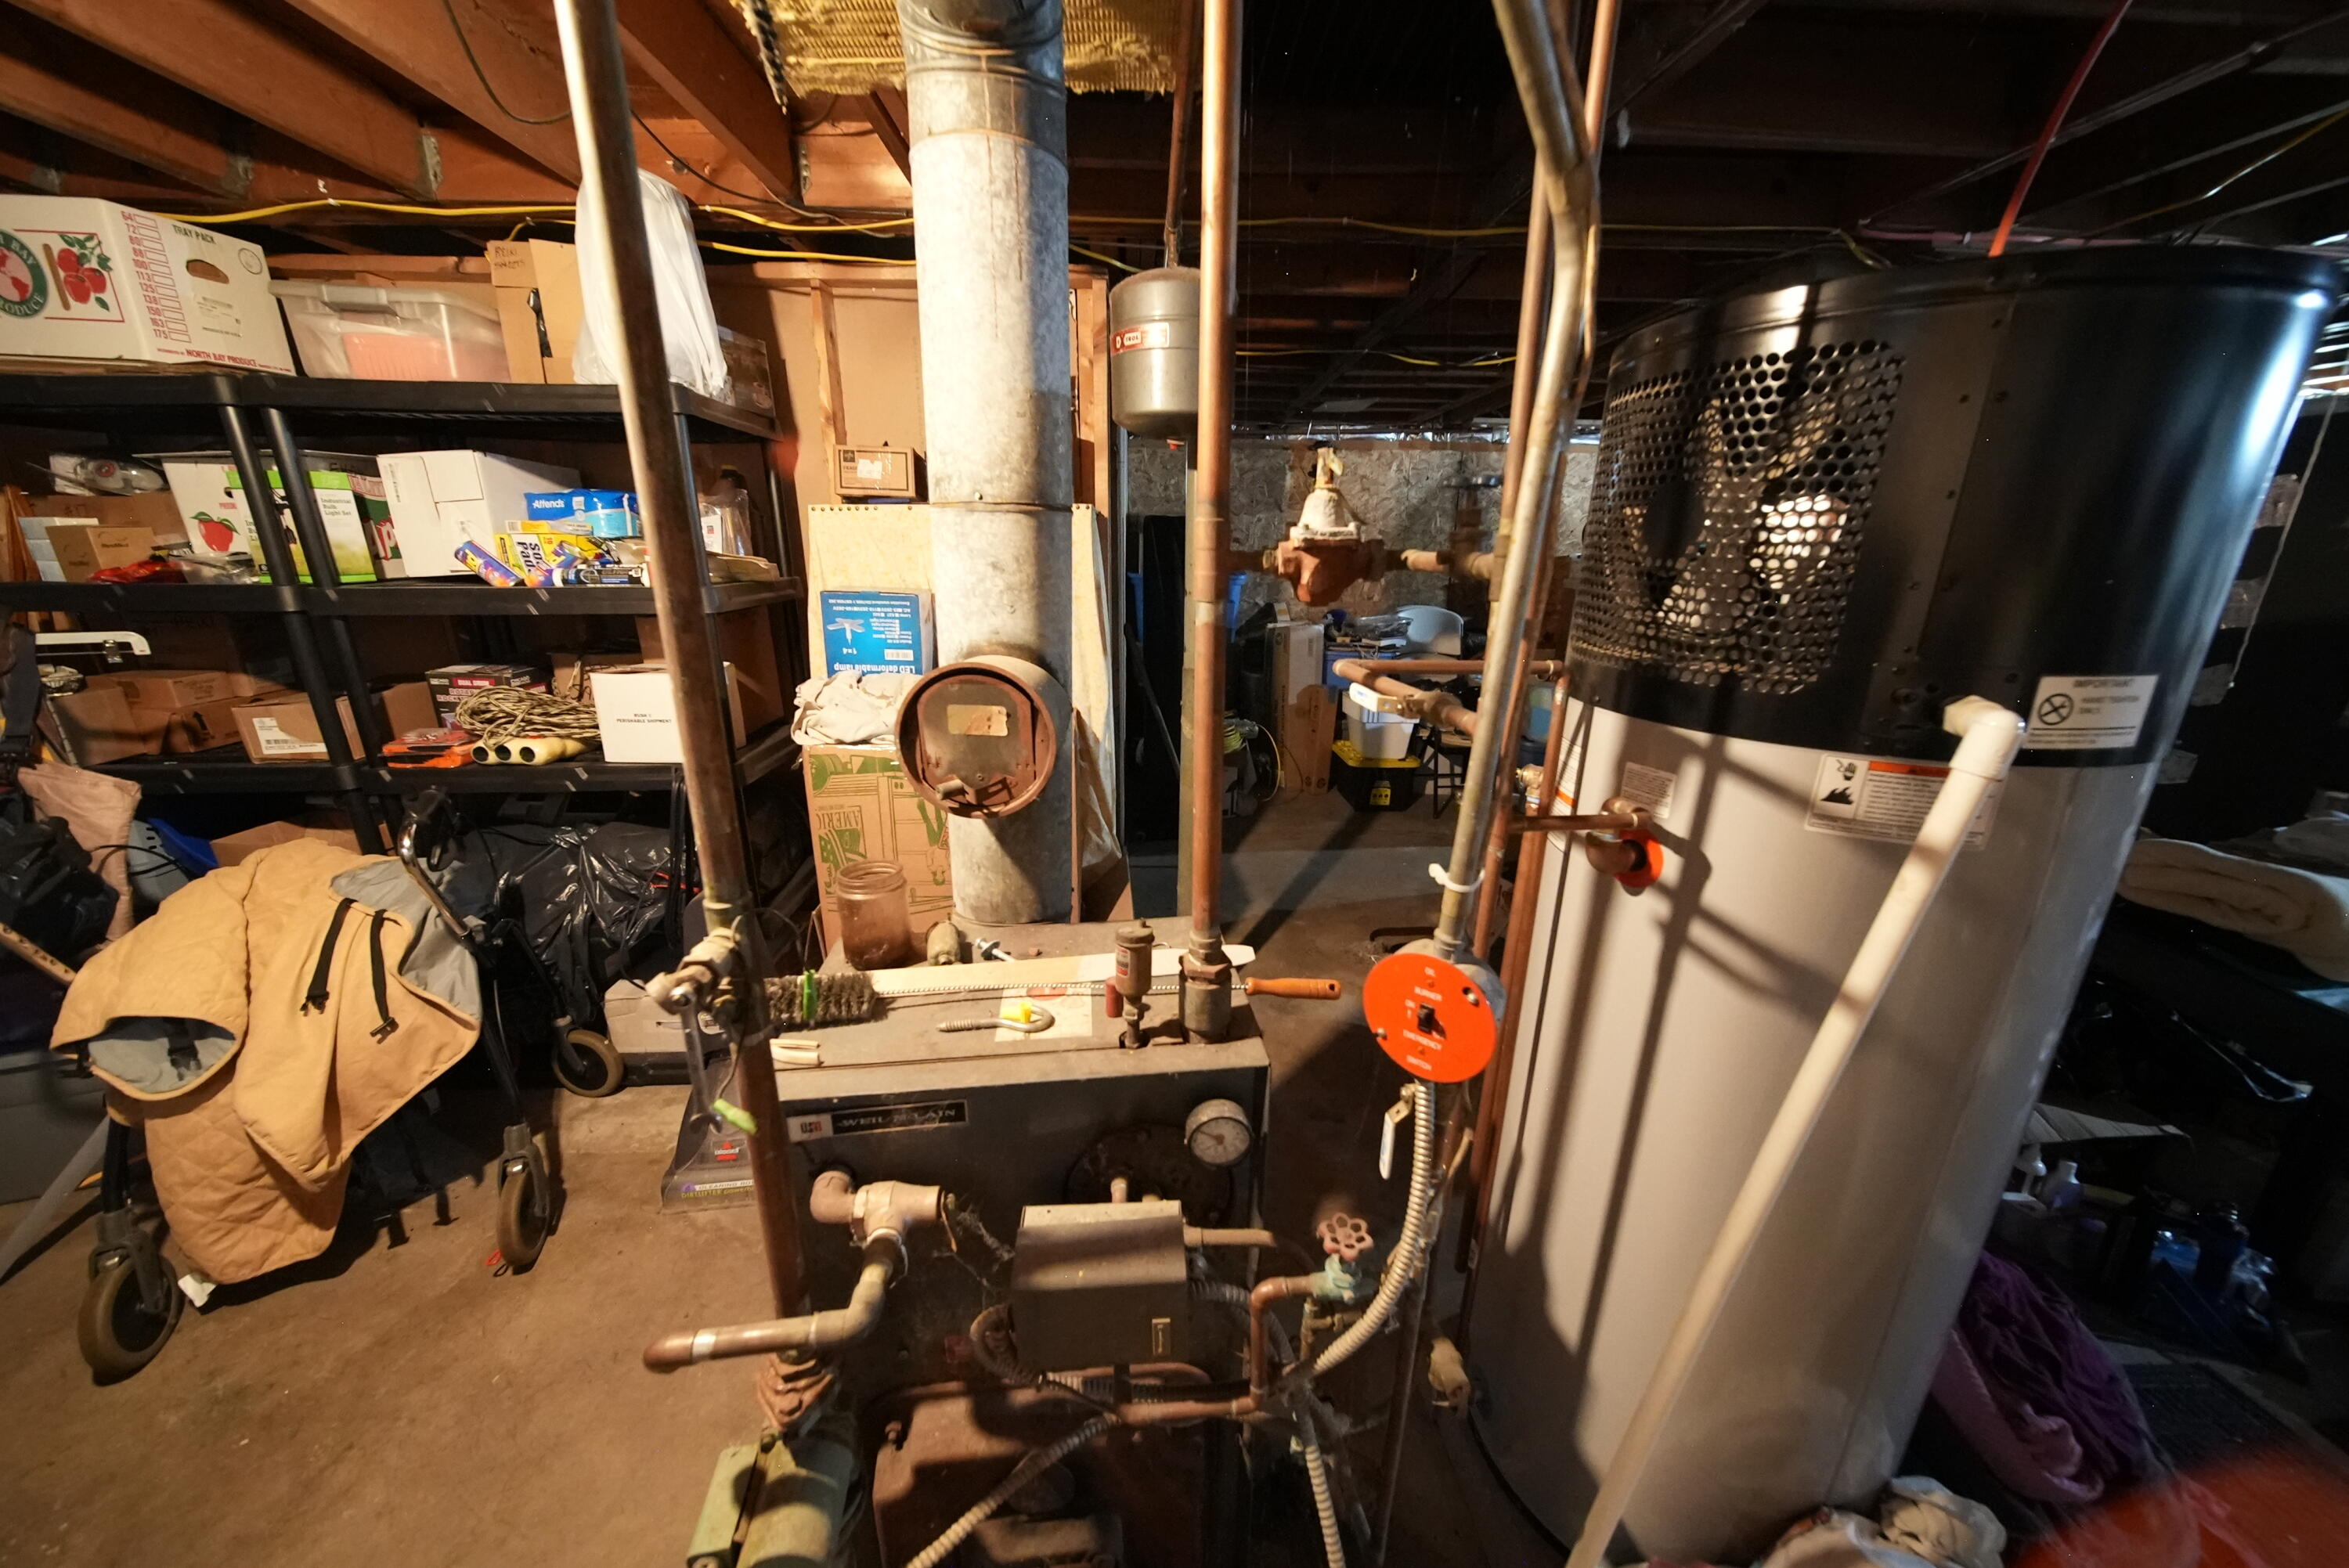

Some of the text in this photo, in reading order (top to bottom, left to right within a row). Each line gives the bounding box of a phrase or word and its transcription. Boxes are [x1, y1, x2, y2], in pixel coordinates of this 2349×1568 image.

[125, 222, 137, 234] 72
[171, 224, 217, 244] TRAY PACK
[136, 271, 152, 283] 113
[139, 282, 155, 294] 125
[153, 329, 168, 339] 175
[186, 349, 211, 359] NORTH
[212, 352, 226, 362] BAY
[227, 355, 257, 367] PRODUCE
[532, 499, 565, 508] Attends
[854, 664, 898, 673] deformable
[1403, 1029, 1442, 1051] EMERGENCY
[1406, 1054, 1432, 1071] SWITCH
